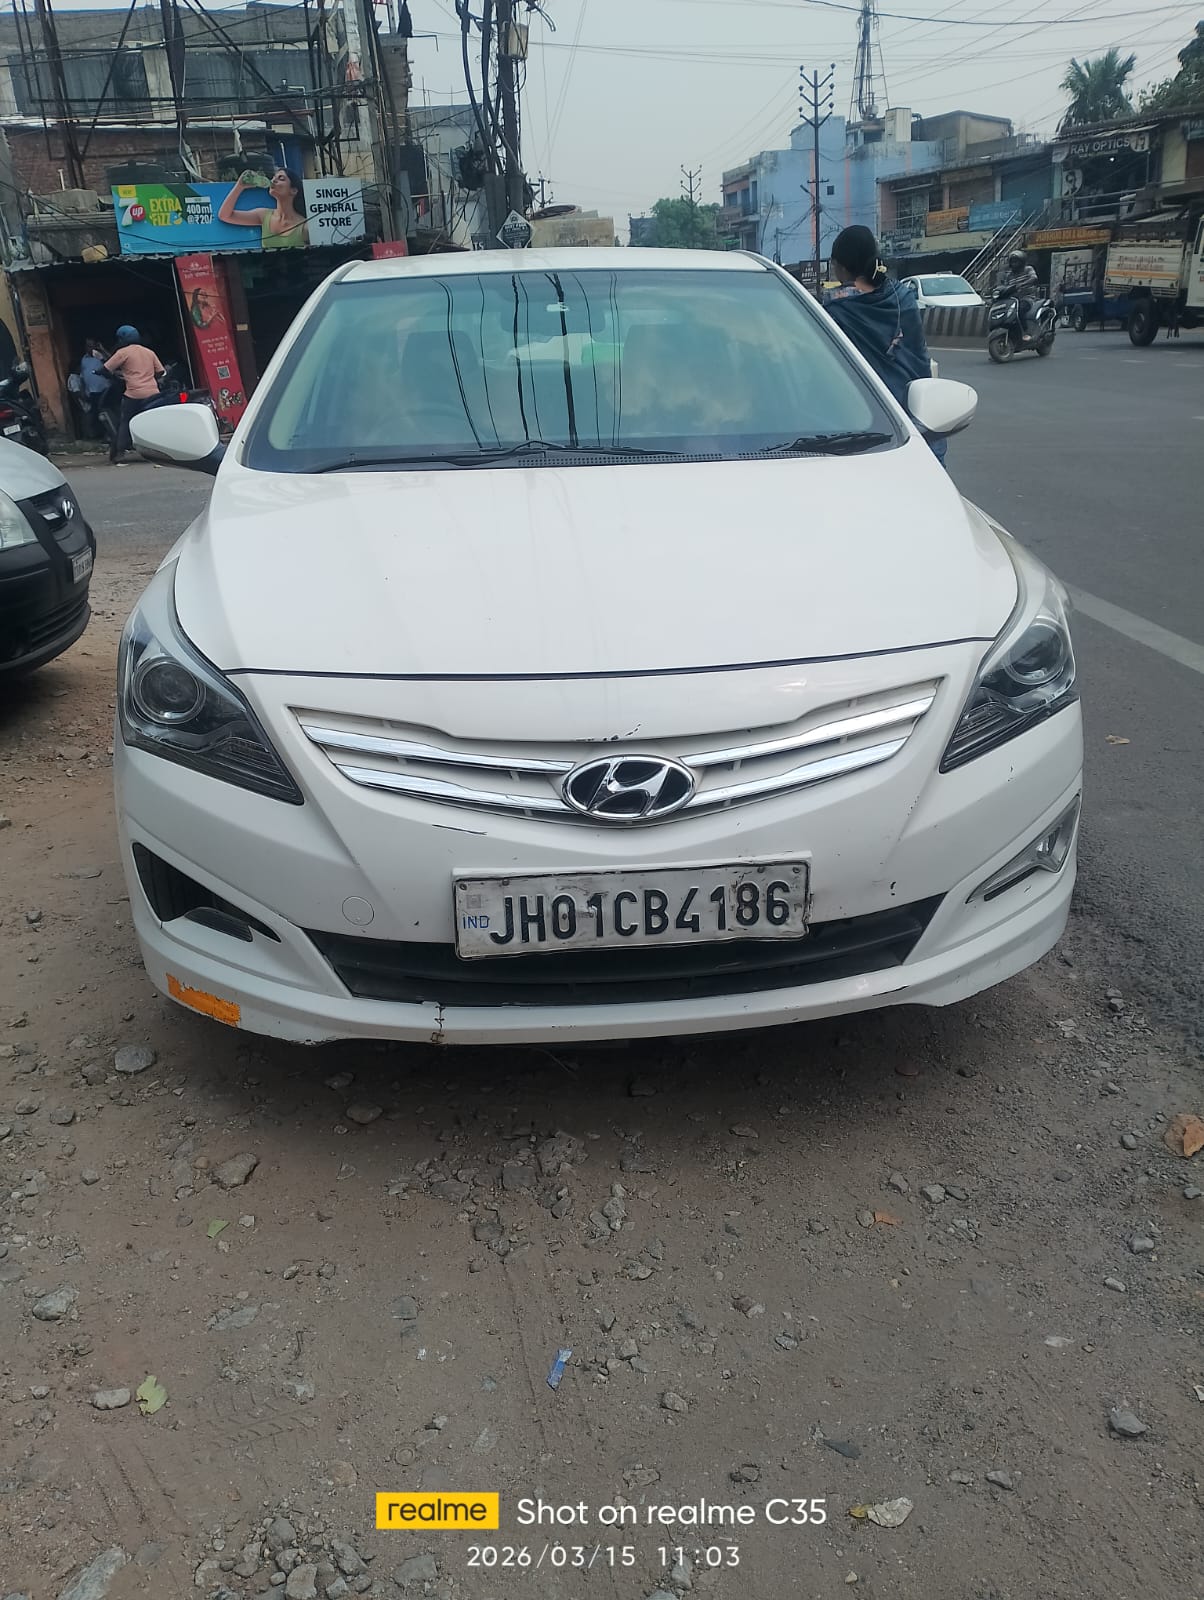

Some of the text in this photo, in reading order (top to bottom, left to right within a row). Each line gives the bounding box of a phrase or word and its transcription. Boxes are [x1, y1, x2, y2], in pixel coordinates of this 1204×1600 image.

[1070, 145, 1089, 155] RAY
[1093, 138, 1130, 151] OPTICS
[315, 188, 348, 198] SINGH
[149, 198, 182, 212] EXTRA
[309, 203, 357, 213] GENERAL
[318, 217, 351, 227] STORE
[489, 880, 790, 945] JH01CB4186
[462, 915, 489, 929] IND
